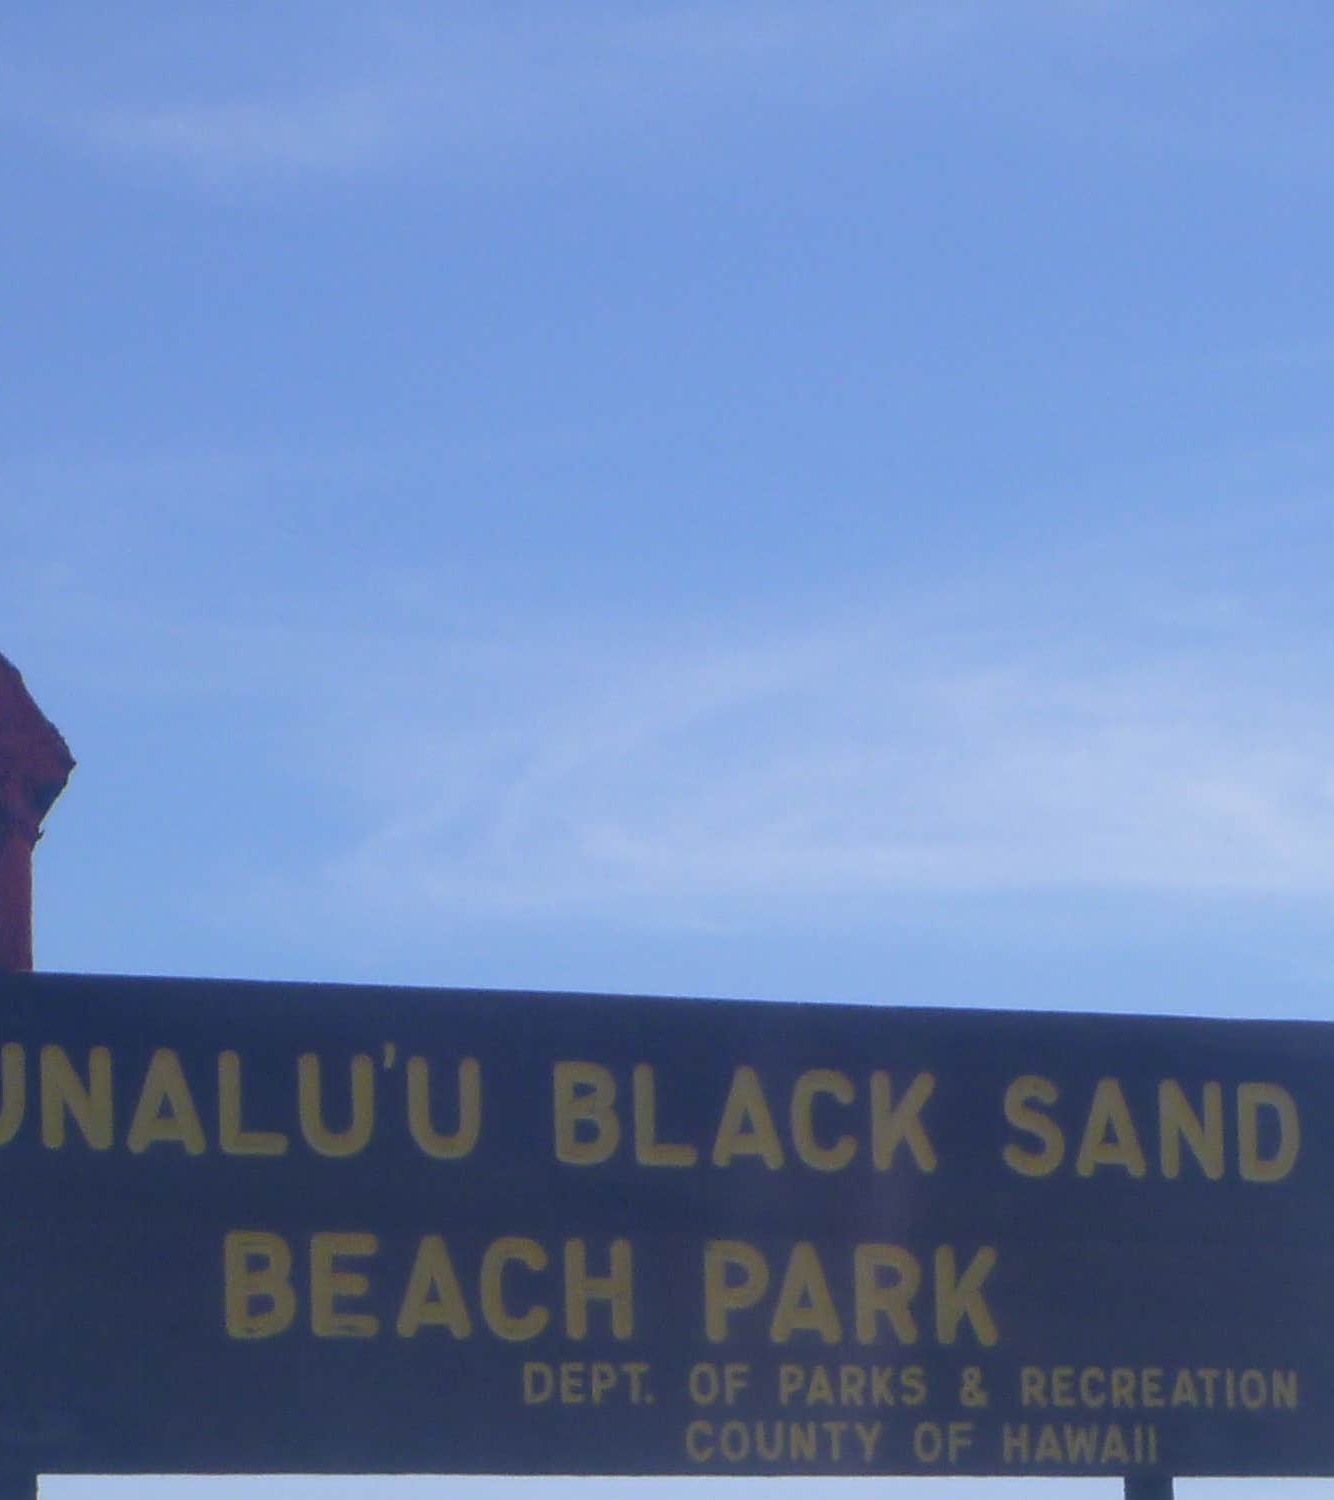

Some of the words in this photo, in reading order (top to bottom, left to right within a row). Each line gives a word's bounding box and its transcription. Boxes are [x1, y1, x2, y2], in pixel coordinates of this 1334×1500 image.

[554, 1061, 938, 1173] BLACK
[1003, 1075, 1300, 1181] SAND
[223, 1229, 634, 1341] BEACH
[703, 1238, 1000, 1347] PARK
[523, 1361, 654, 1404] DEPT.
[689, 1361, 751, 1406] OF
[779, 1362, 927, 1406] PARKS
[960, 1365, 988, 1407] &
[1021, 1366, 1298, 1408] RECREATION
[685, 1419, 882, 1461] COUNTY
[915, 1421, 972, 1462] OF
[1003, 1424, 1156, 1461] HAWAII
